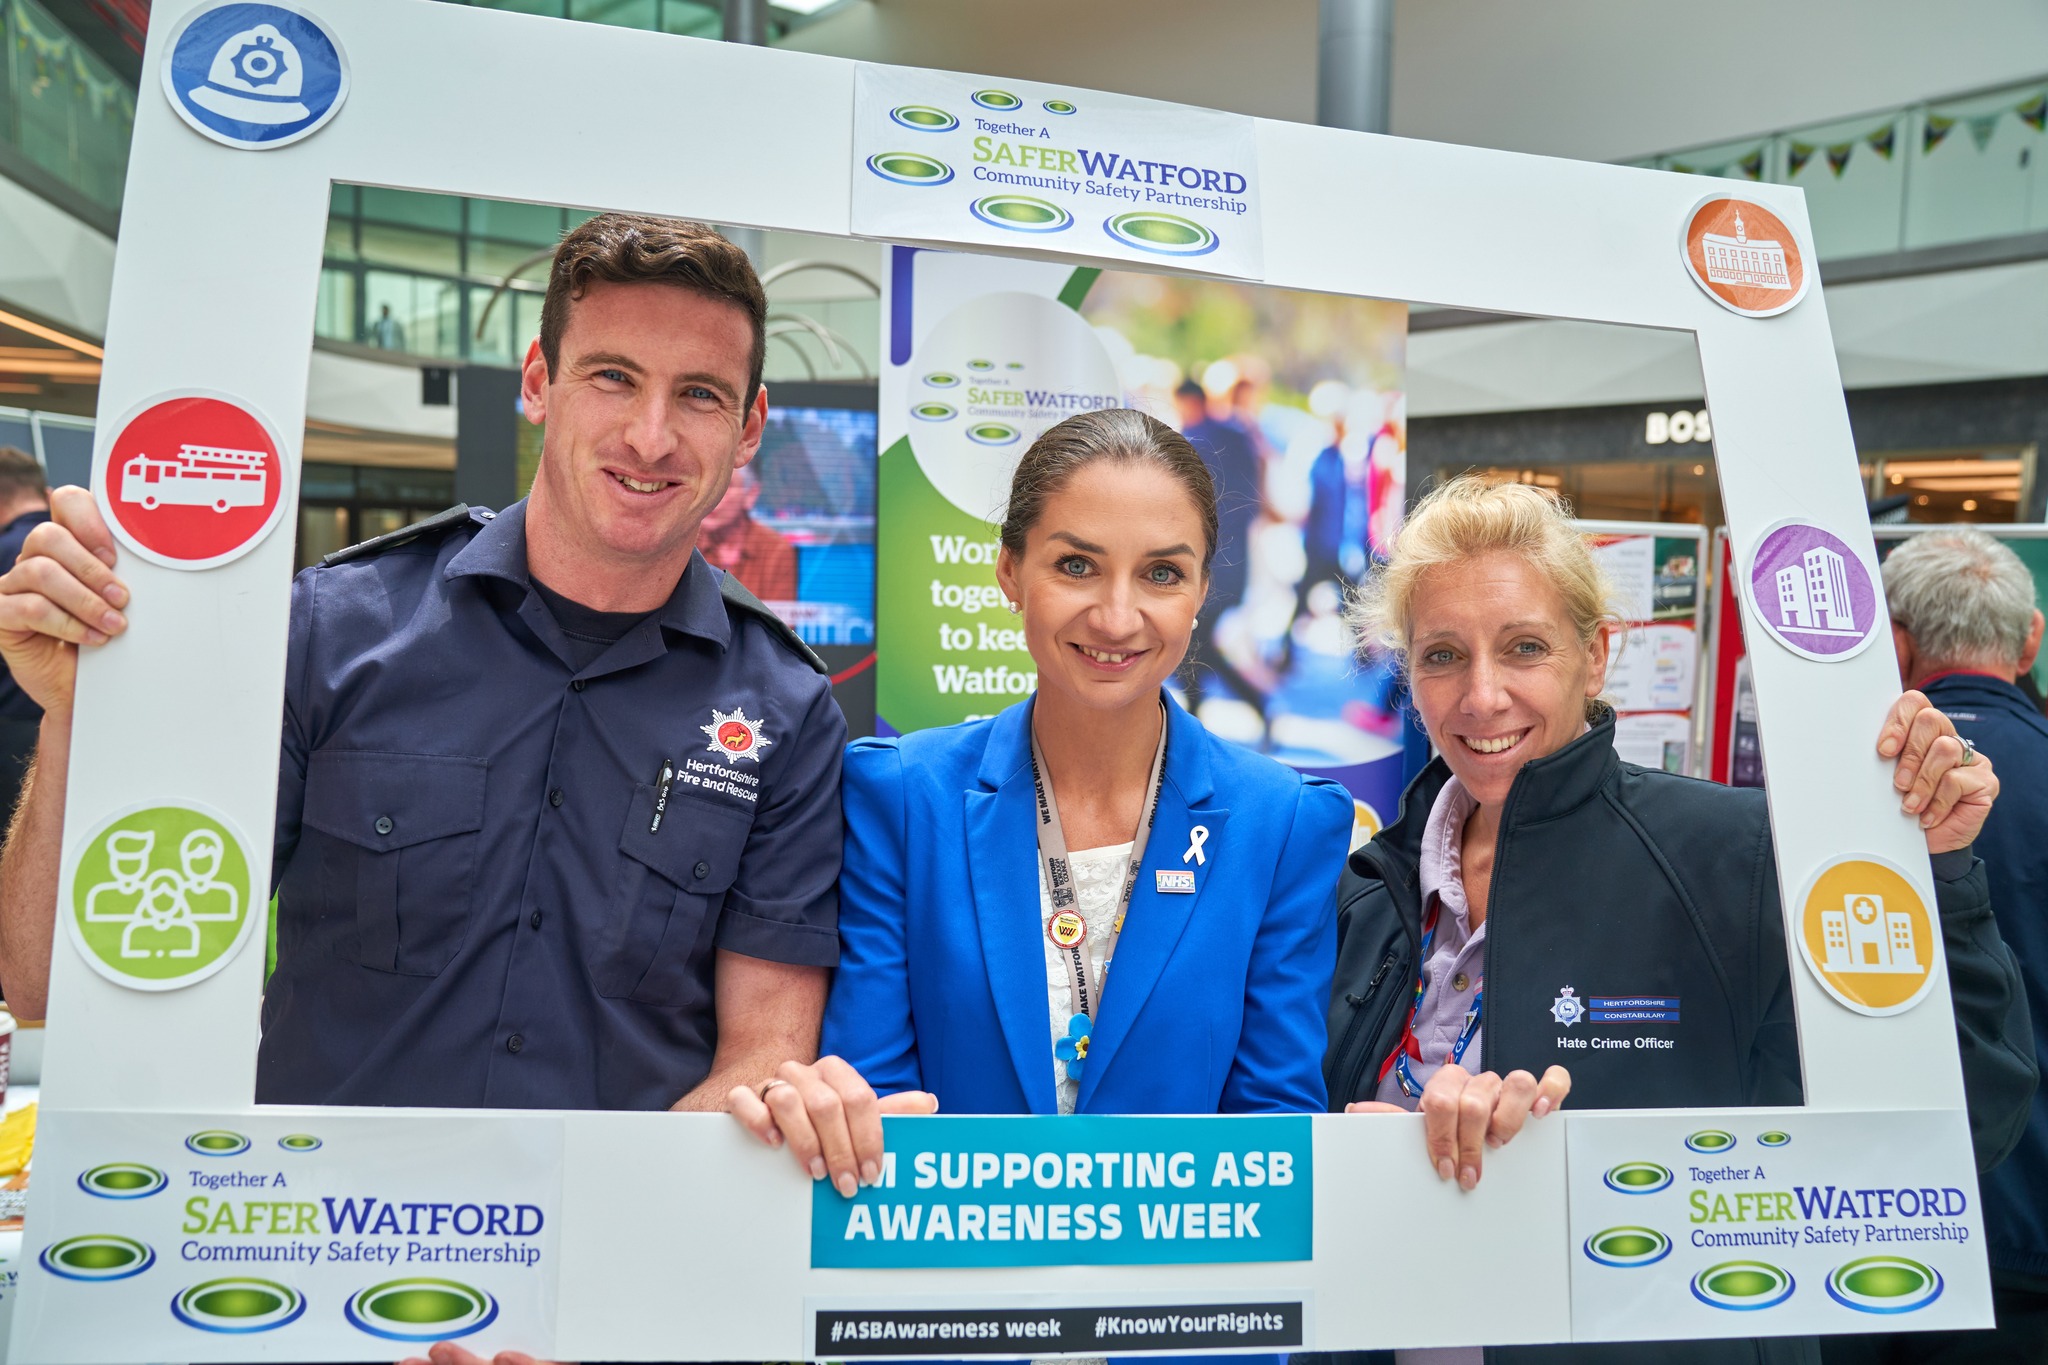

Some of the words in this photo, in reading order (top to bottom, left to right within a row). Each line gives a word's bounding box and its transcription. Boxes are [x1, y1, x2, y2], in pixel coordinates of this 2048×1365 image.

[975, 118, 1035, 137] Together
[1039, 127, 1050, 138] A
[973, 166, 1081, 194] Community
[1085, 180, 1140, 201] Safety
[1145, 188, 1246, 214] Partnership
[967, 406, 1025, 419] Community
[1646, 409, 1712, 444] BOS
[939, 623, 973, 651] to
[977, 623, 1029, 652] kee
[933, 665, 1038, 695] Watfor
[677, 770, 700, 786] Fire
[702, 779, 726, 792] and
[726, 782, 758, 802] Rescue
[686, 759, 759, 787] Hertfordshire
[1035, 780, 1047, 808] MAKE
[1041, 808, 1051, 825] WE
[1048, 857, 1059, 888] WATFORD
[1054, 857, 1065, 885] BOROUGH
[1059, 858, 1070, 883] COUNCIL
[1161, 875, 1190, 887] NHS
[1071, 946, 1087, 987] WATFOR
[1557, 1037, 1587, 1049] Hate
[1591, 1037, 1630, 1049] Crime
[1634, 1037, 1674, 1049] Officer
[189, 1171, 268, 1190] Together
[272, 1172, 287, 1187] A
[914, 1152, 1196, 1189] SUPPORTING
[1211, 1151, 1294, 1187] ASB
[1689, 1166, 1750, 1184] Together
[1754, 1166, 1766, 1180] A
[844, 1203, 1123, 1240] AWARENESS
[1138, 1202, 1261, 1239] WEEK
[1691, 1227, 1799, 1248] Community
[1804, 1225, 1860, 1246] Safety
[1864, 1222, 1969, 1243] Partnership
[181, 1240, 322, 1265] Community
[327, 1241, 401, 1266] Safety
[406, 1241, 541, 1267] Partnership
[830, 1320, 1000, 1342] #ASBAwareness
[1006, 1319, 1061, 1338] week
[1094, 1312, 1284, 1338] #KnowYourRights
